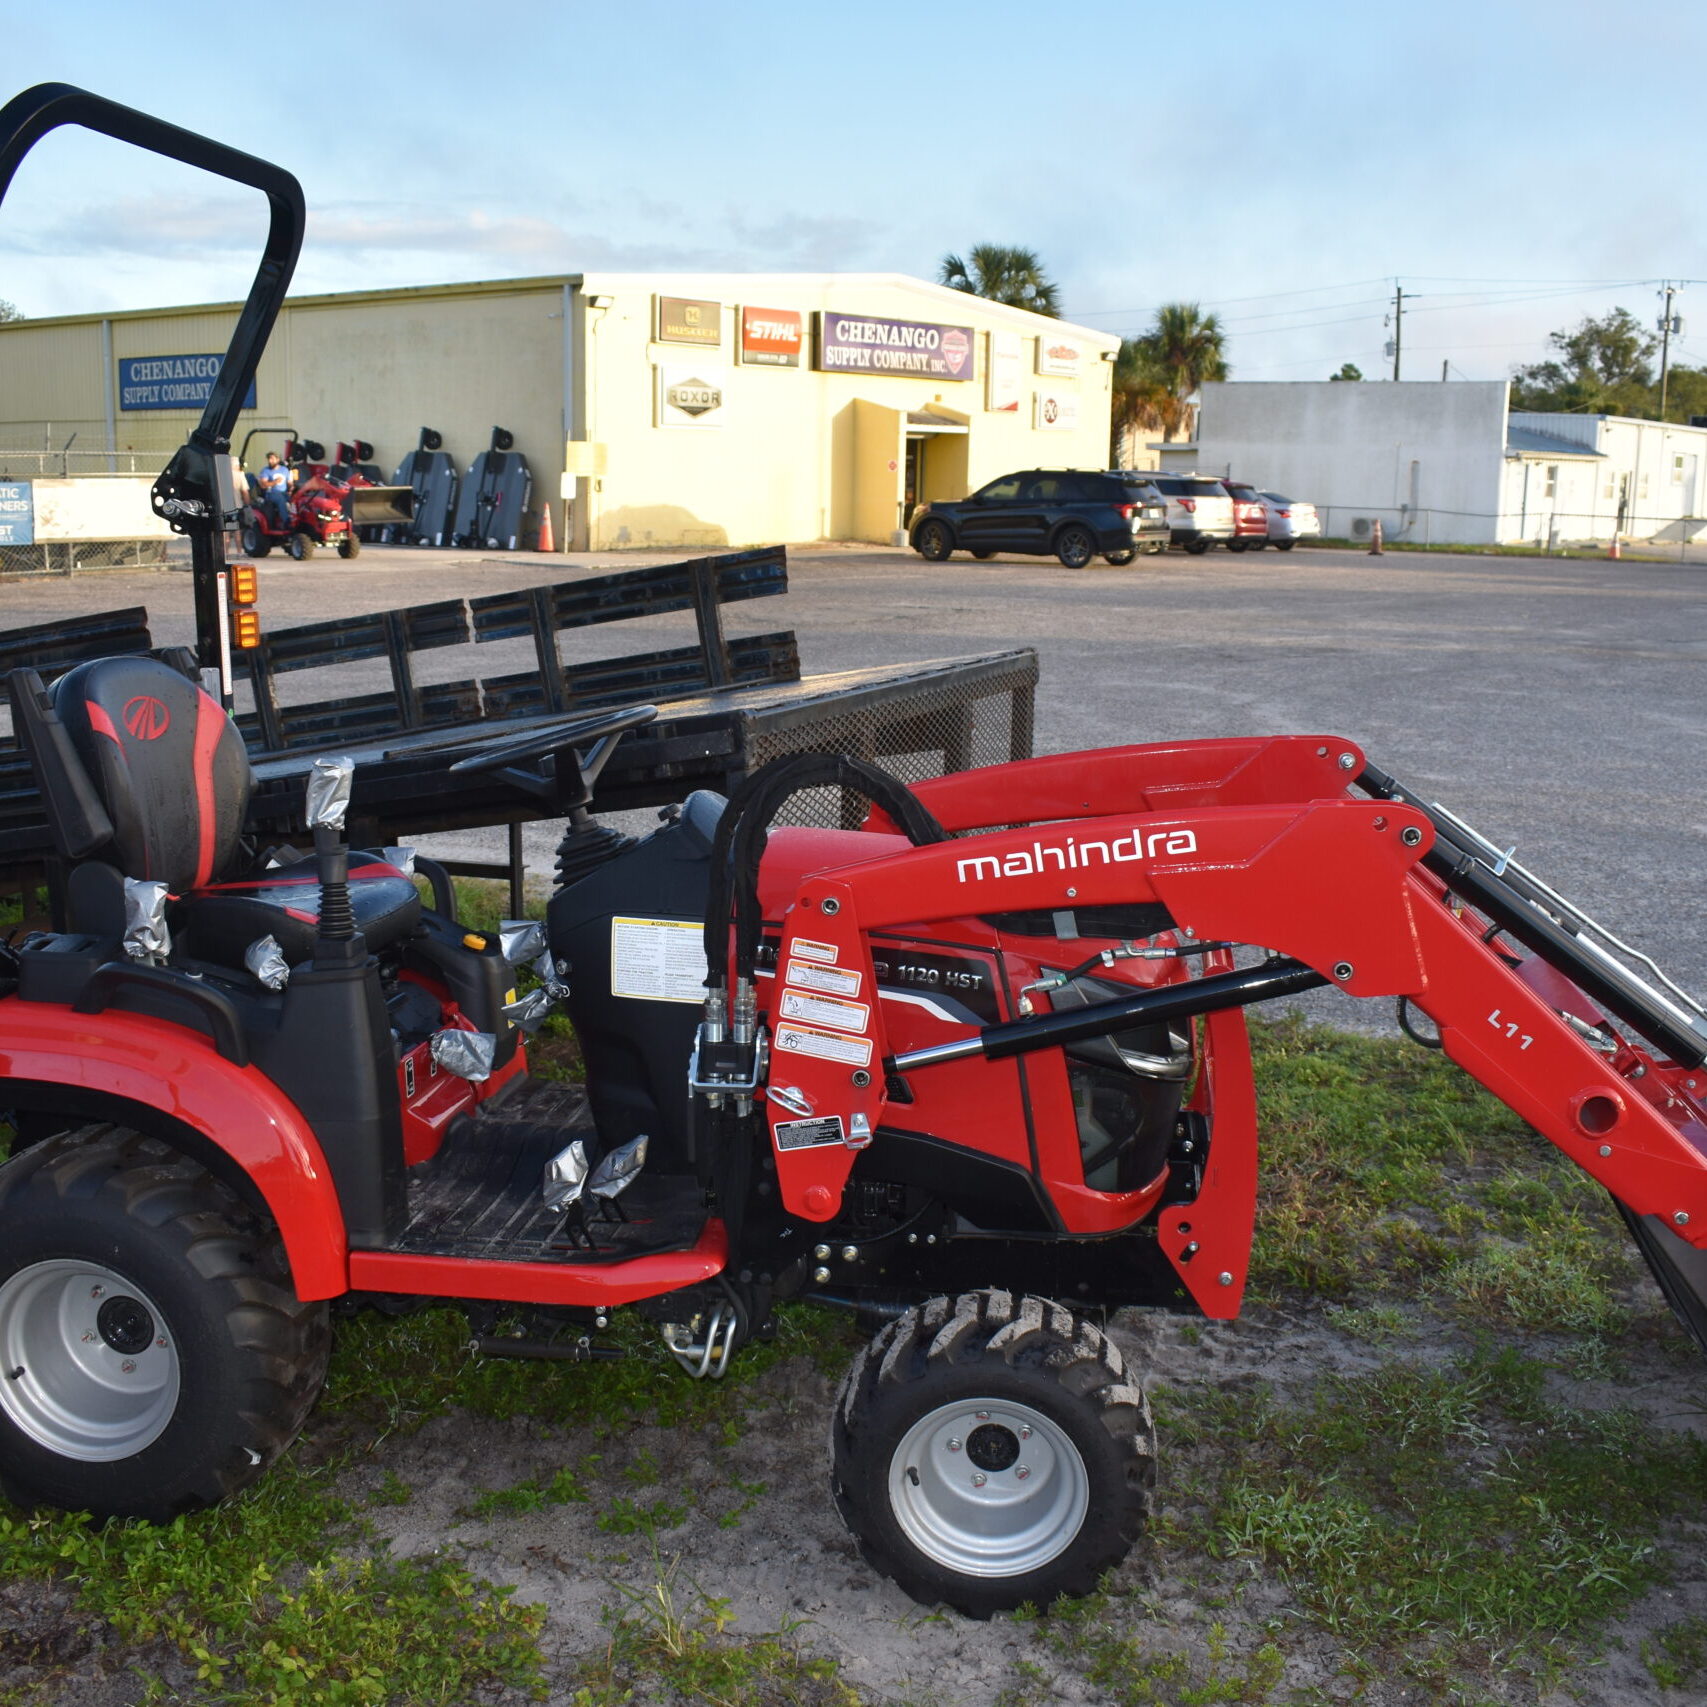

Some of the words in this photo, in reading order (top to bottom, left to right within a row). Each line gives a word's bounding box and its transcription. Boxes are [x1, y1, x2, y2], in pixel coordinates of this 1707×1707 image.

[750, 320, 798, 342] STIHL
[836, 319, 939, 350] CHENANGO
[826, 345, 871, 367] SUPPLY
[131, 357, 219, 381] CHENANGO
[124, 385, 160, 404] SUPPLY
[161, 382, 211, 402] COMPANY
[669, 390, 720, 405] ROXOR
[957, 829, 1197, 882] mahindra
[806, 942, 830, 951] WARNING
[814, 966, 841, 975] WARNING
[898, 964, 939, 984] 1120
[945, 971, 984, 990] HST
[816, 996, 844, 1006] WARNING
[814, 1030, 842, 1040] WARNING
[1488, 1009, 1534, 1050] L11
[790, 1119, 825, 1128] INSTRUCTION
